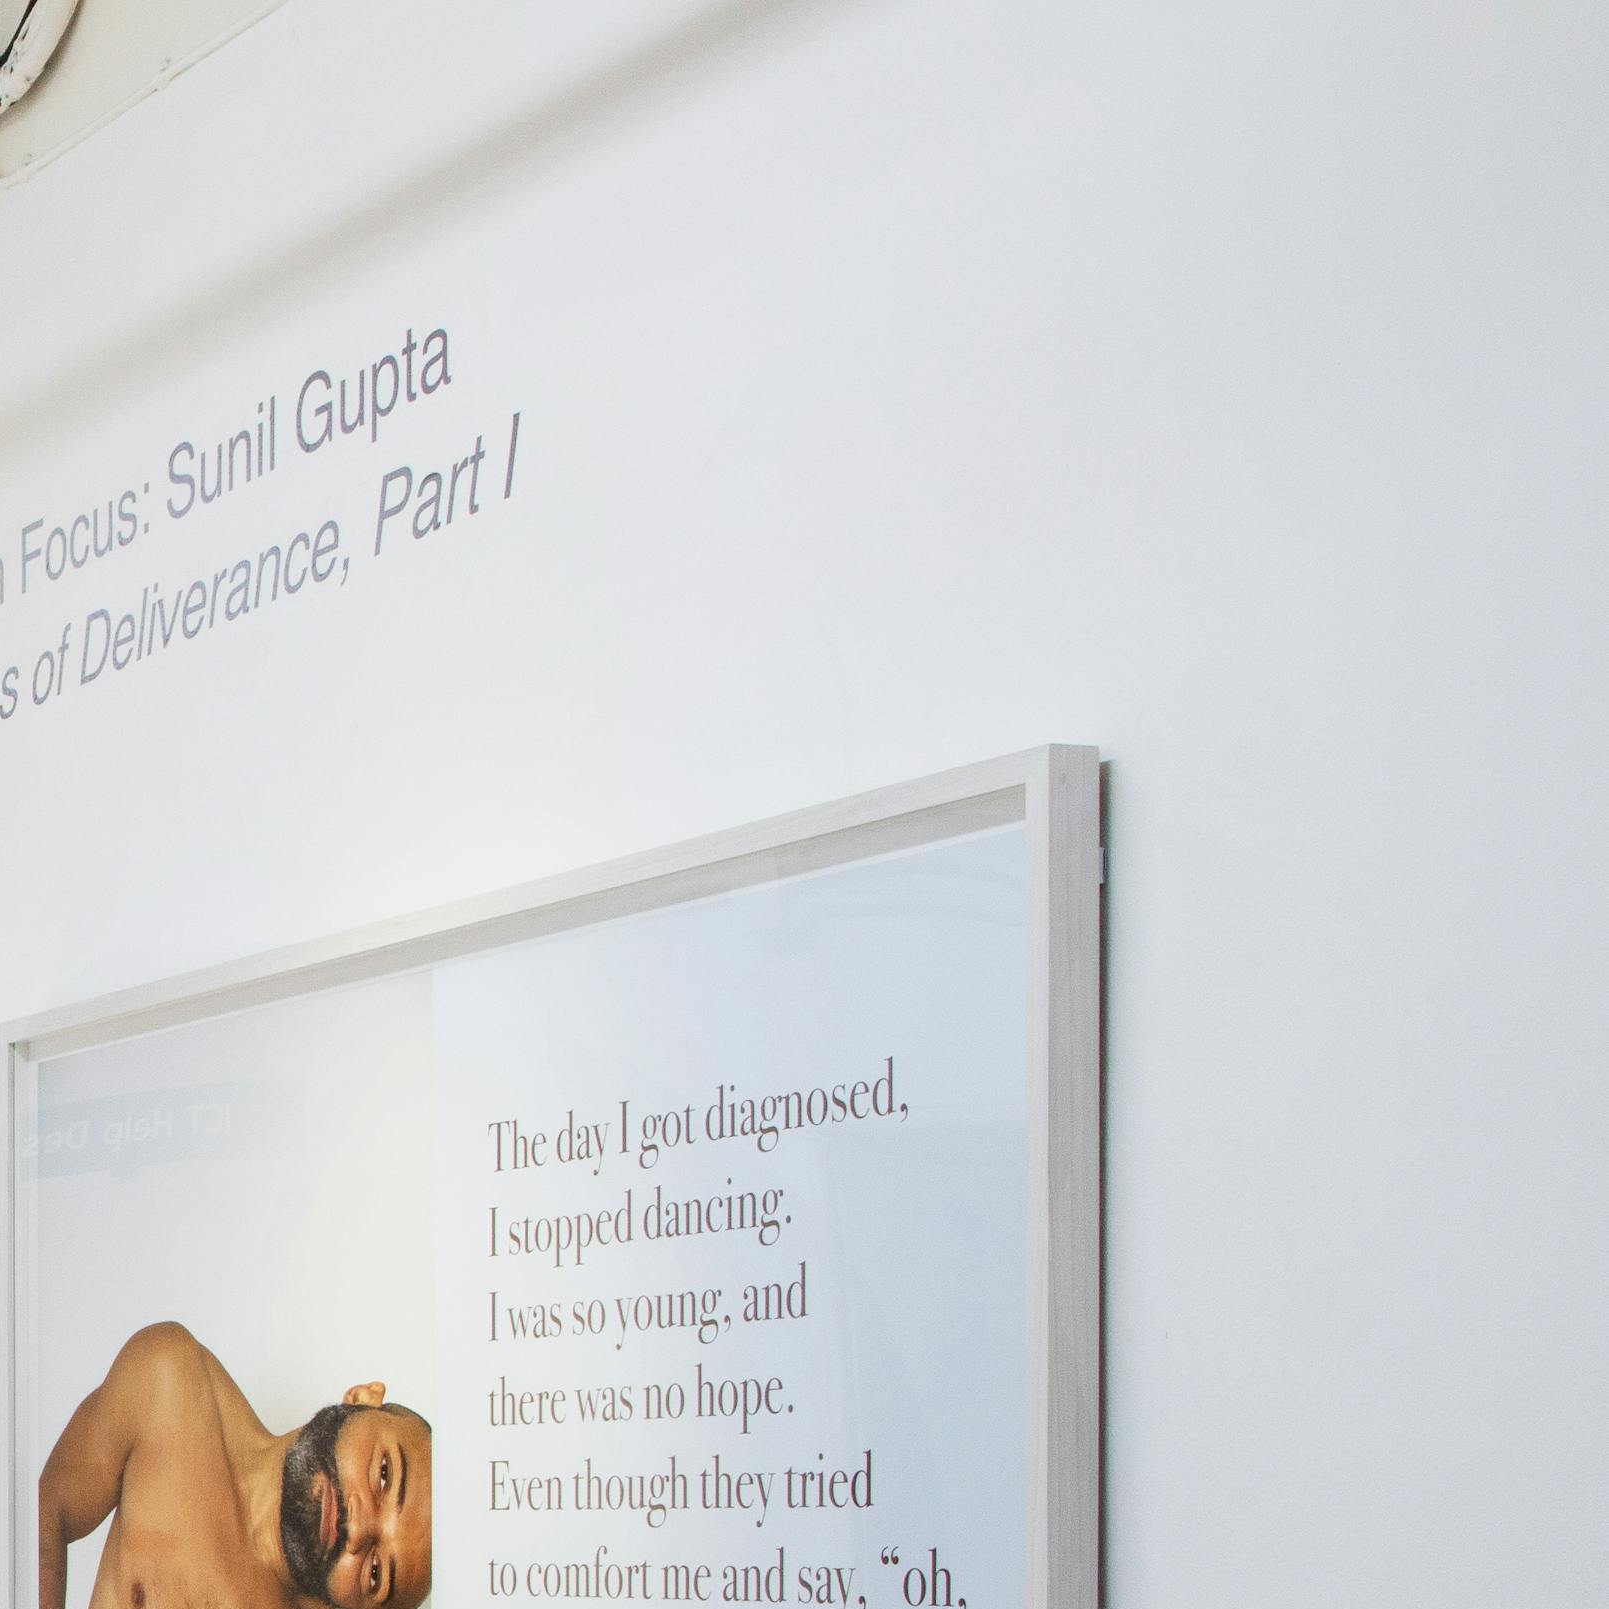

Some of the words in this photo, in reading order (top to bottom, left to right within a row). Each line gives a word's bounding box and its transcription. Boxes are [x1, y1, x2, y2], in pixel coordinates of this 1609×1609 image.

[21, 481, 151, 595] Focus:
[166, 396, 277, 519] Sunil
[294, 328, 452, 453] Gupta
[32, 623, 71, 705] of
[81, 519, 351, 686] Deliverance,
[374, 434, 485, 556] Part
[504, 412, 521, 499] I
[488, 1120, 547, 1172] The
[557, 1111, 611, 1176] day
[619, 1101, 630, 1154] I
[639, 1110, 697, 1170] got
[705, 1056, 909, 1152] diagnosed,
[488, 1207, 499, 1256] I
[508, 1189, 634, 1267] stopped
[644, 1178, 792, 1246] dancing.
[488, 1291, 499, 1341] I
[507, 1302, 562, 1340] was
[573, 1299, 606, 1335] so
[615, 1287, 733, 1350] young,
[743, 1261, 809, 1322] and
[488, 1376, 566, 1427] there
[575, 1386, 633, 1422] was
[643, 1381, 685, 1421] no
[695, 1364, 795, 1435] hope.
[488, 1460, 563, 1511] Even
[574, 1458, 689, 1528] though
[700, 1456, 776, 1528] they
[785, 1450, 874, 1509] tried
[488, 1556, 517, 1598] to
[527, 1545, 652, 1601] comfort
[662, 1563, 711, 1602] me
[722, 1548, 785, 1603] and
